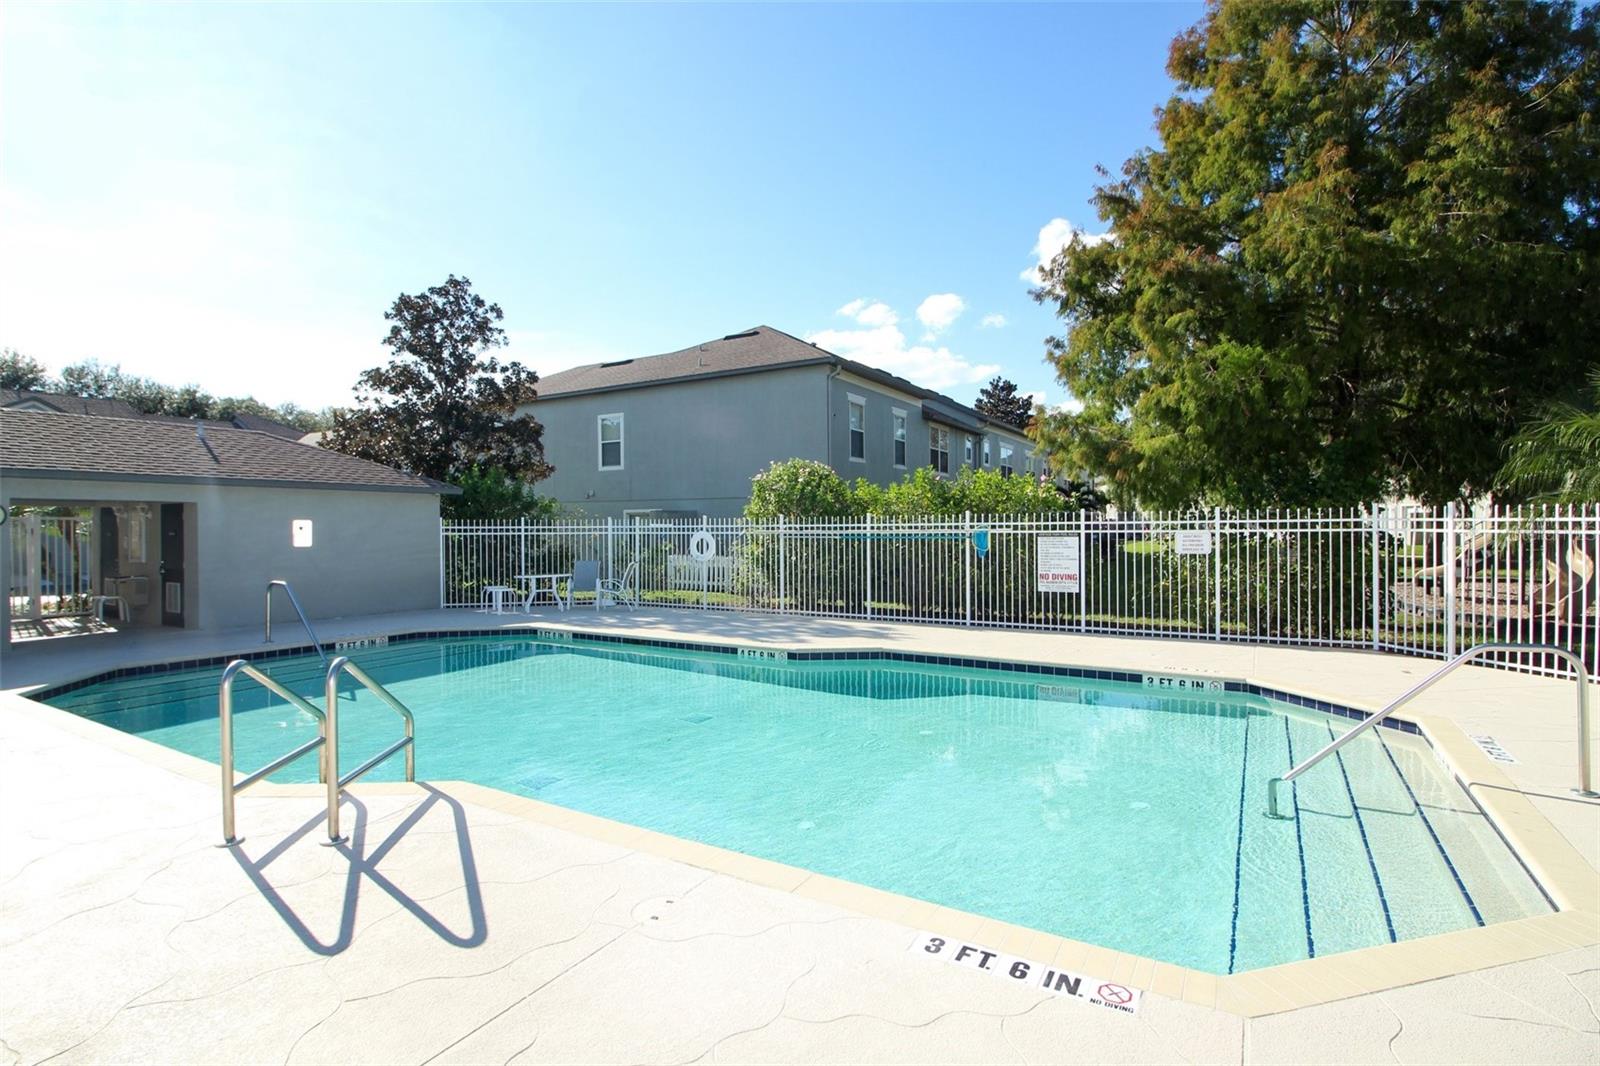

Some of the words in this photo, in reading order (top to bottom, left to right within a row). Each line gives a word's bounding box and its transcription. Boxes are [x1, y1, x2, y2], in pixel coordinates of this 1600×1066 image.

[1039, 573, 1050, 581] NO
[1051, 573, 1078, 581] DIVING
[1191, 681, 1204, 689] IN
[924, 937, 946, 954] 3
[954, 945, 997, 970] FT.
[1008, 961, 1031, 980] 6
[1042, 970, 1083, 998] IN.
[1104, 1002, 1134, 1014] DIVING
